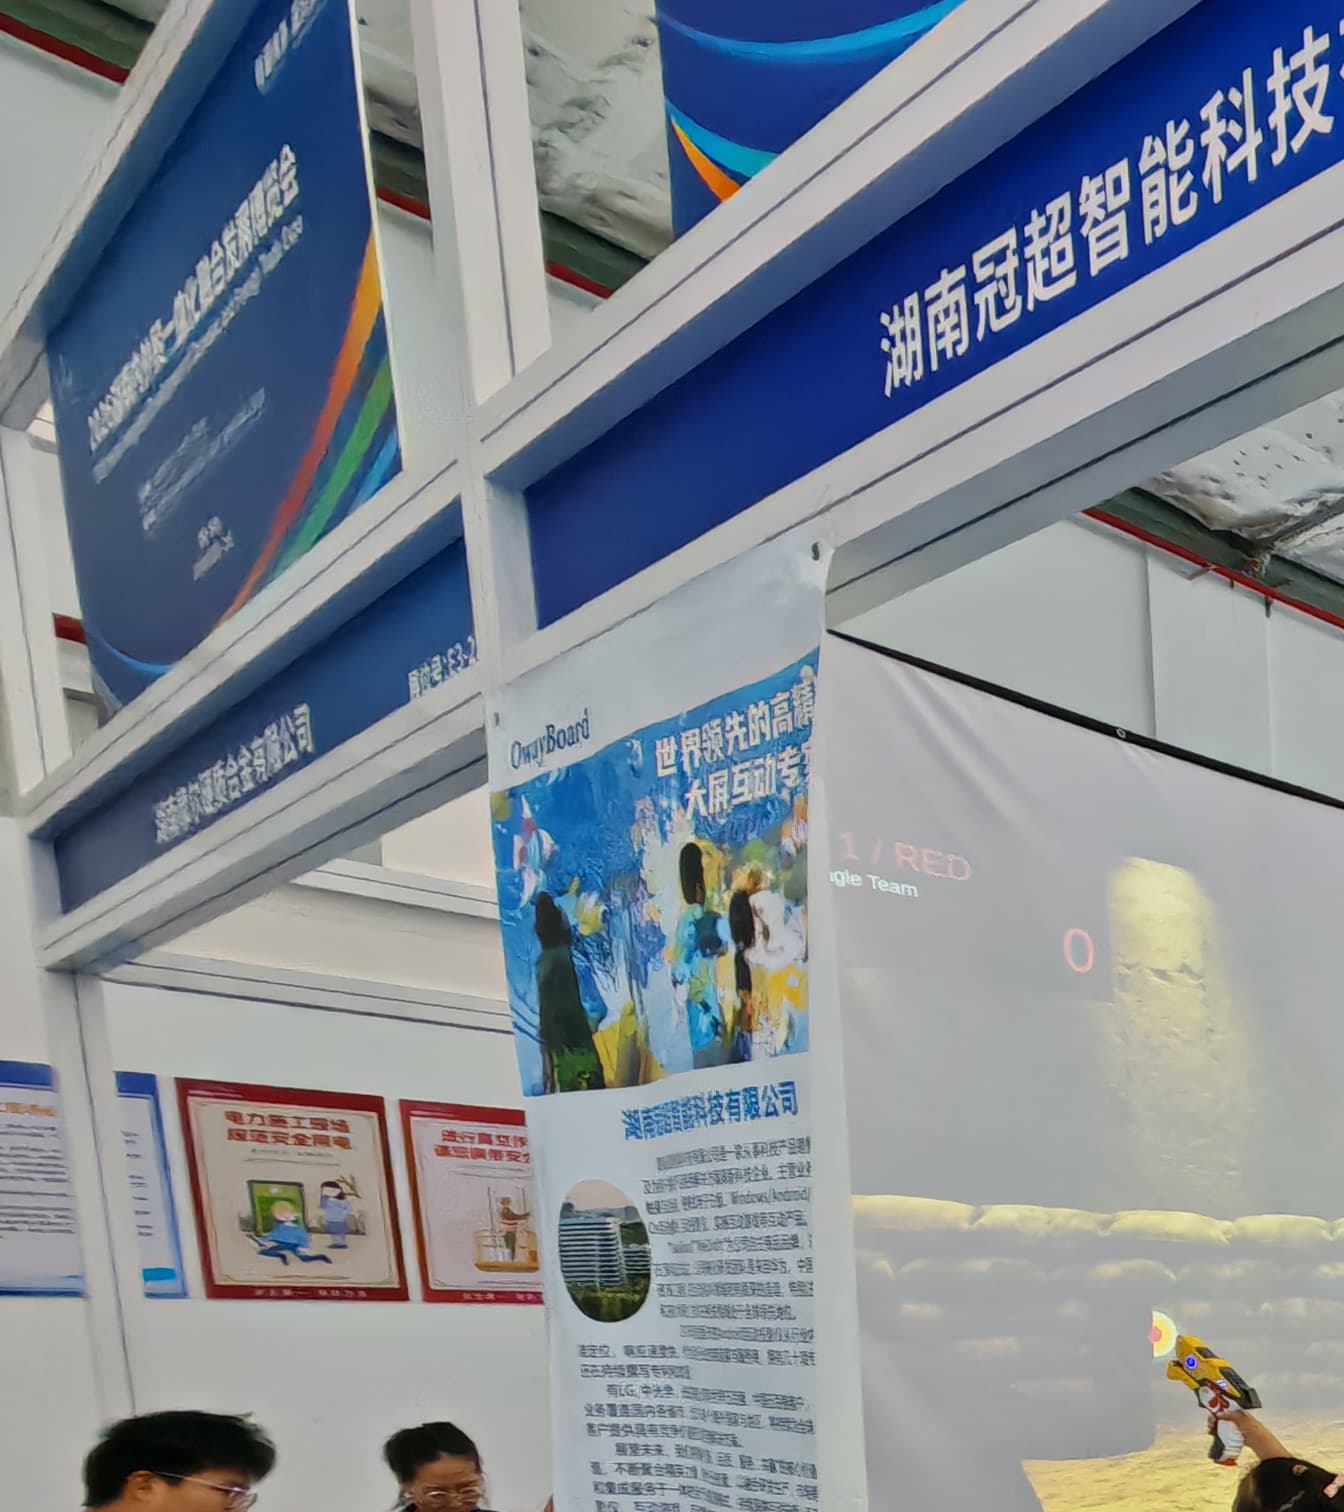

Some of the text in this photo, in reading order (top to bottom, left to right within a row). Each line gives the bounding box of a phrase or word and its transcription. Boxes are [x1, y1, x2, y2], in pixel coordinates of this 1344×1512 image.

[895, 841, 972, 881] RED
[866, 873, 919, 897] Team
[1062, 928, 1095, 974] 0
